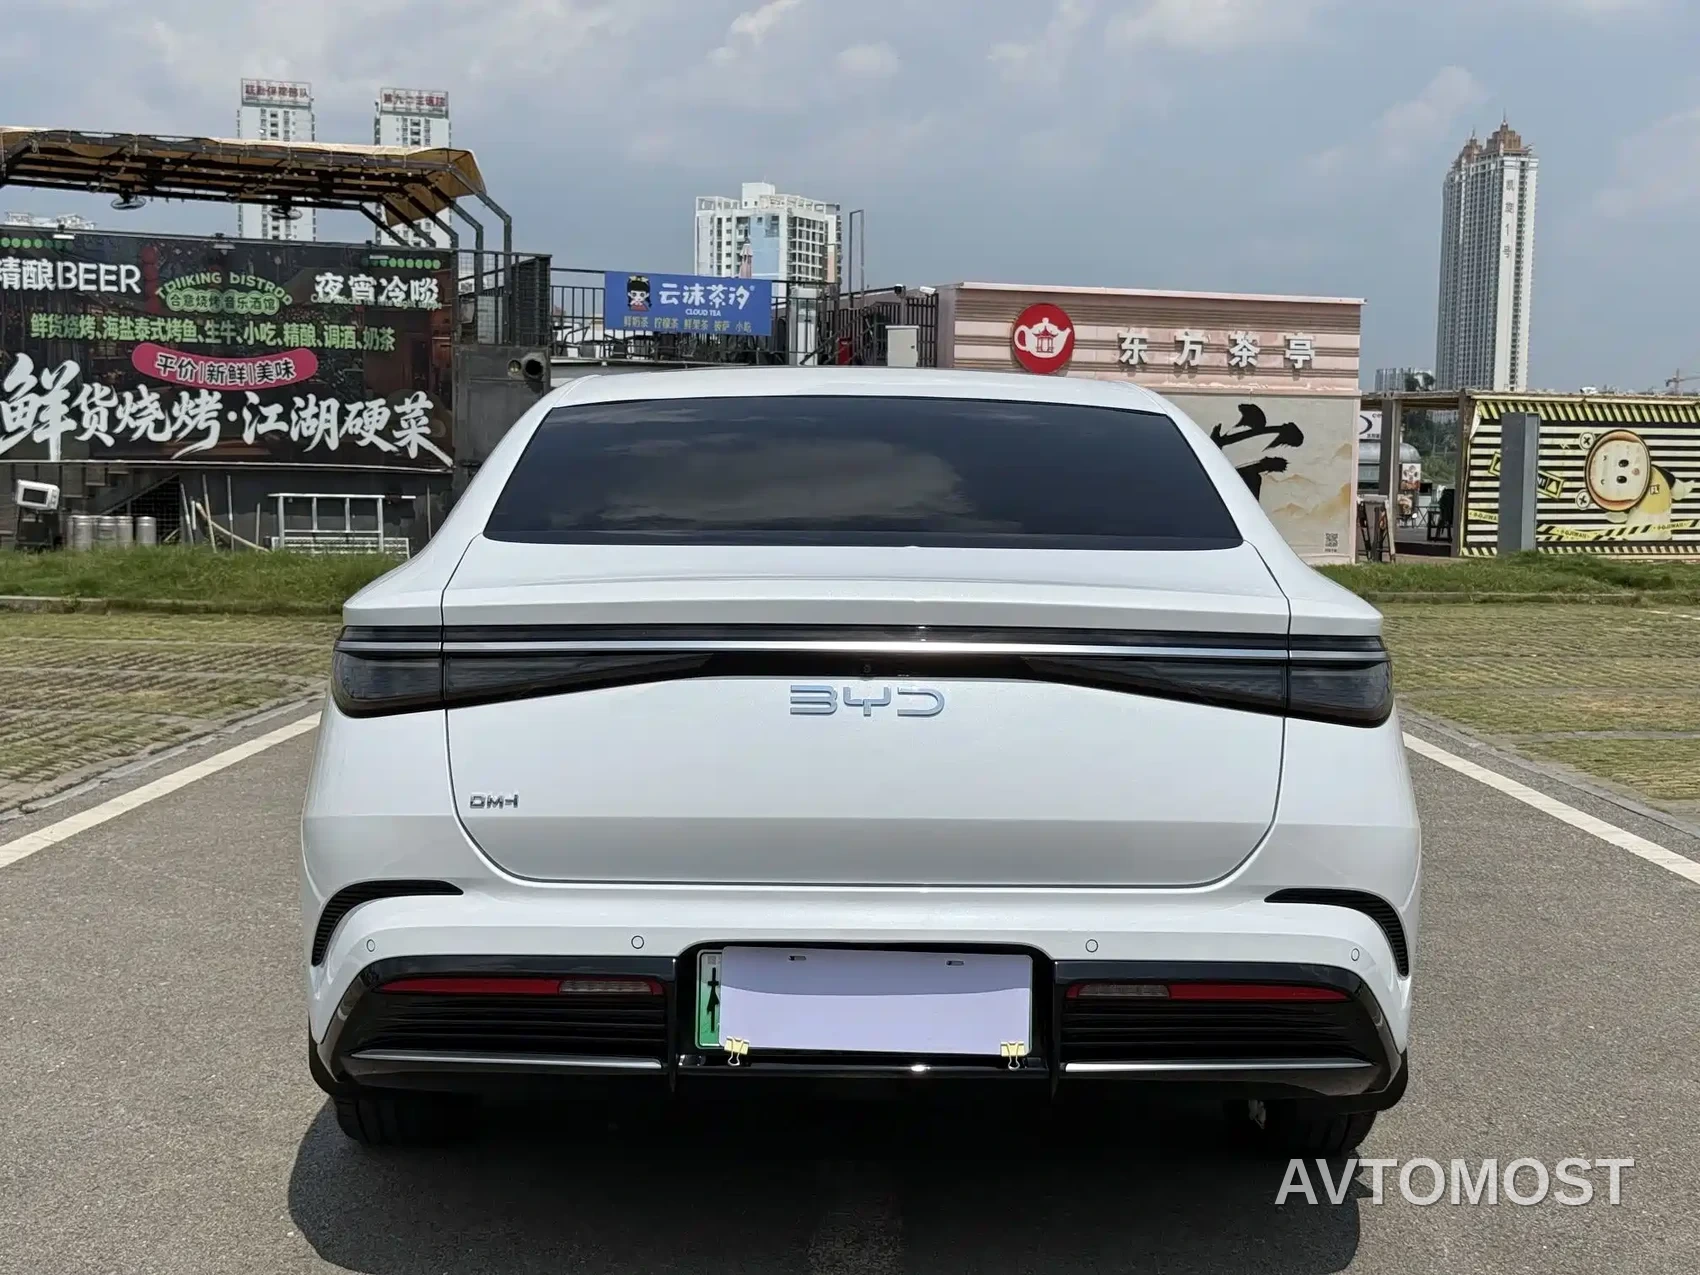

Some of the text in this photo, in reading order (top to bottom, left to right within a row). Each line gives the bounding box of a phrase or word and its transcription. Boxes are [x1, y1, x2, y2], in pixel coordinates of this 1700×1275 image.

[685, 308, 721, 317] CLOUD TEA
[1118, 330, 1315, 369] 东方茶亭
[790, 685, 945, 717] BYD
